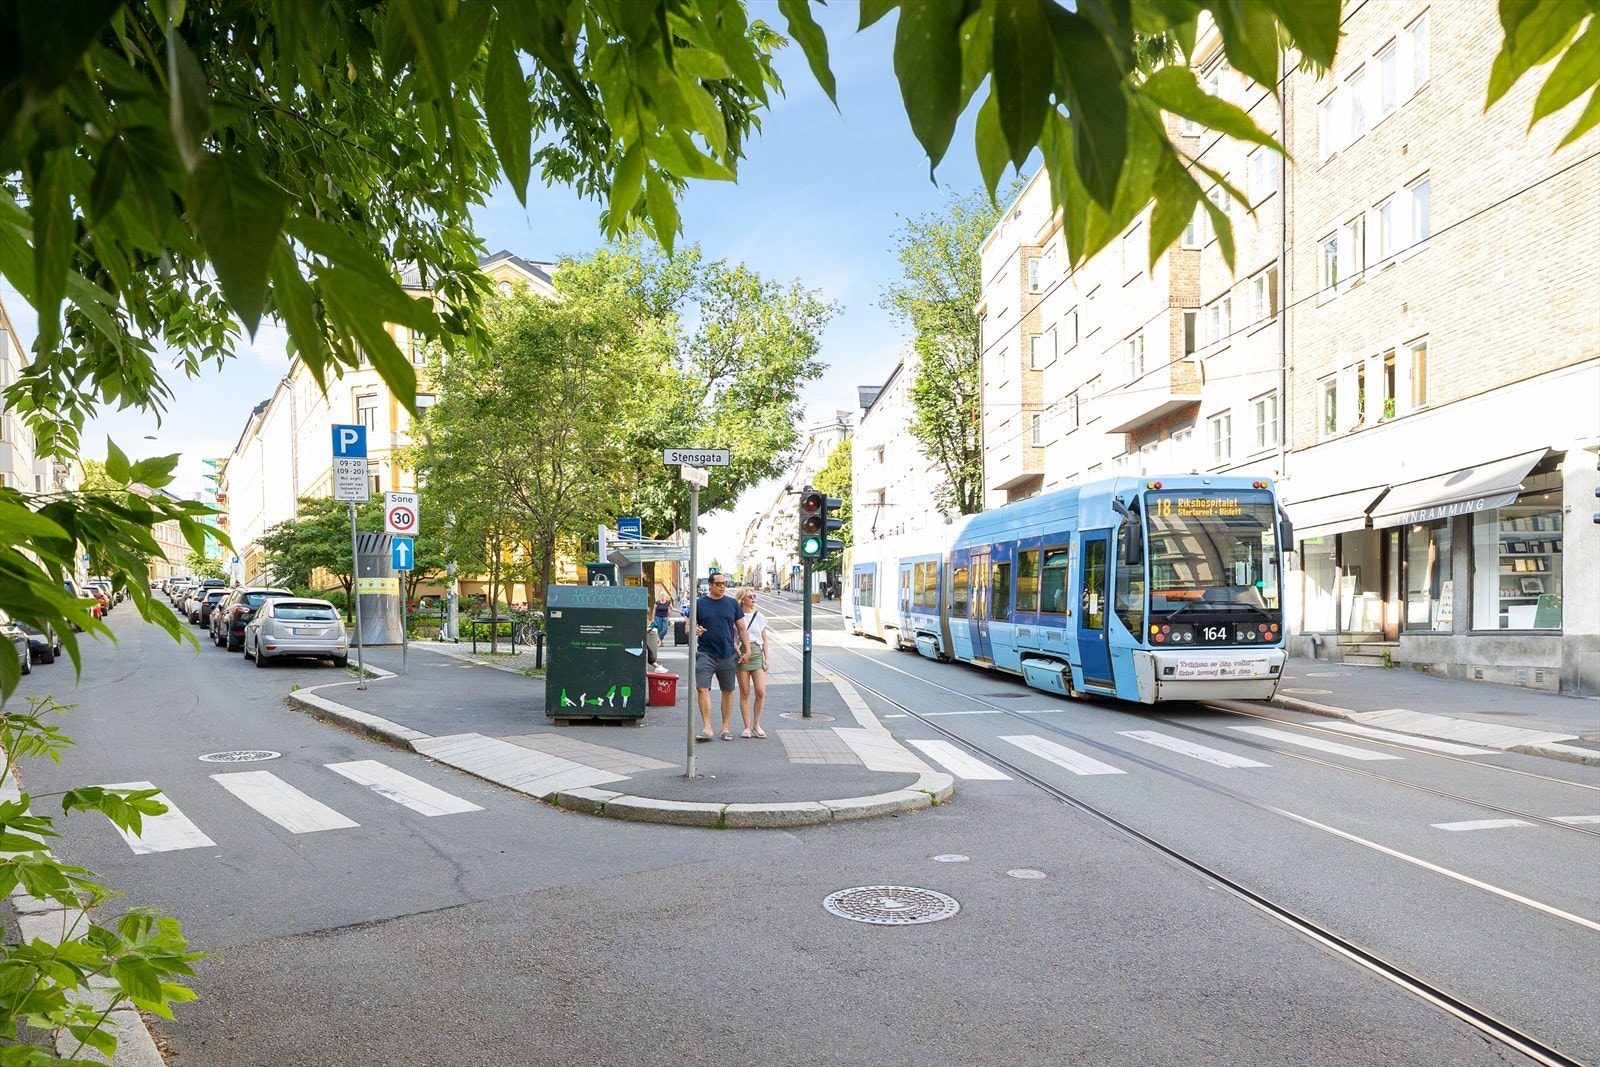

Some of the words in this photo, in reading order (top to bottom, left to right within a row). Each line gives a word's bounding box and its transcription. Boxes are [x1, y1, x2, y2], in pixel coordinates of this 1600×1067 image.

[340, 429, 359, 453] P
[671, 452, 722, 464] Stensgata
[391, 495, 413, 504] Sone
[1157, 498, 1171, 517] 18
[1178, 498, 1238, 508] Rikshospitalet
[1178, 507, 1213, 516] Stortorvet
[1219, 507, 1241, 516] Bislett
[1397, 498, 1485, 525] INNRAMMING
[394, 513, 410, 525] 30
[1203, 627, 1227, 640] 164
